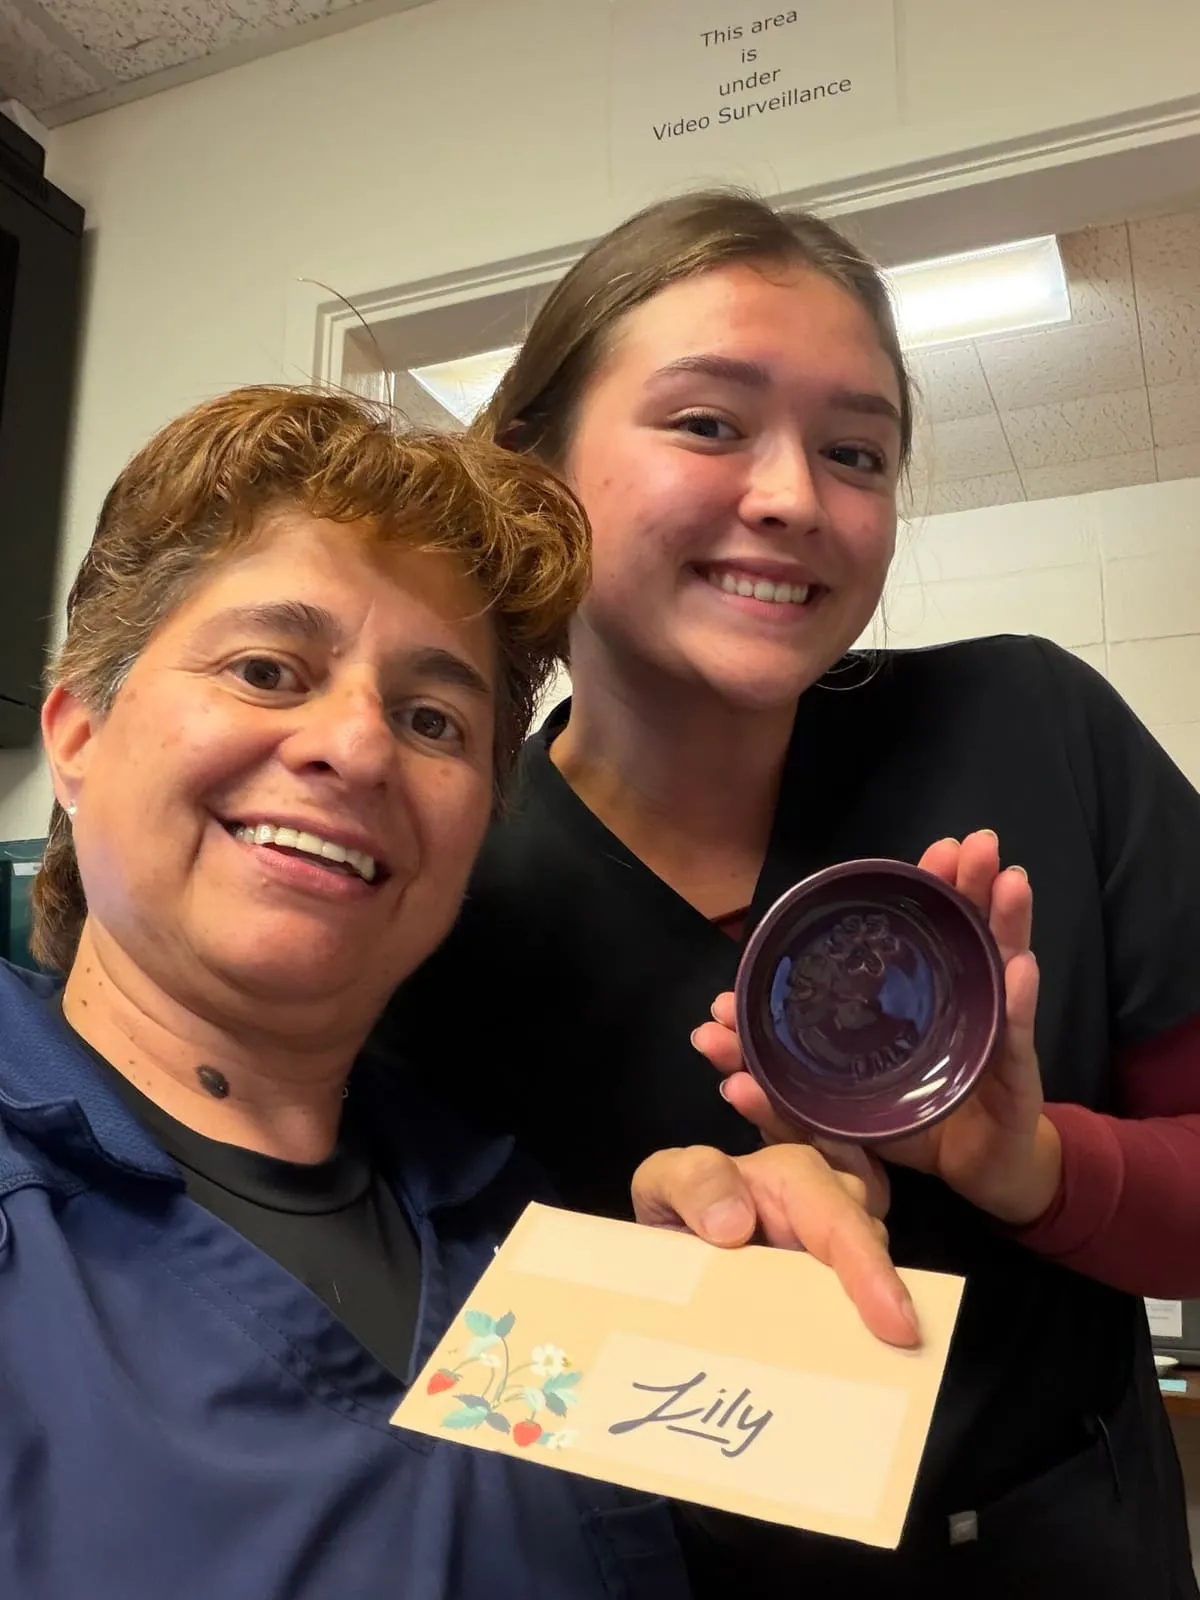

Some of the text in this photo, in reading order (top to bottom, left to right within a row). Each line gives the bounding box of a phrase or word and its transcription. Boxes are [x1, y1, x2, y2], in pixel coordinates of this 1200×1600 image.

[701, 10, 797, 47] This area
[741, 48, 758, 63] is
[719, 68, 781, 96] under
[653, 78, 852, 141] Video Surveillance
[608, 1371, 773, 1458] Lily
